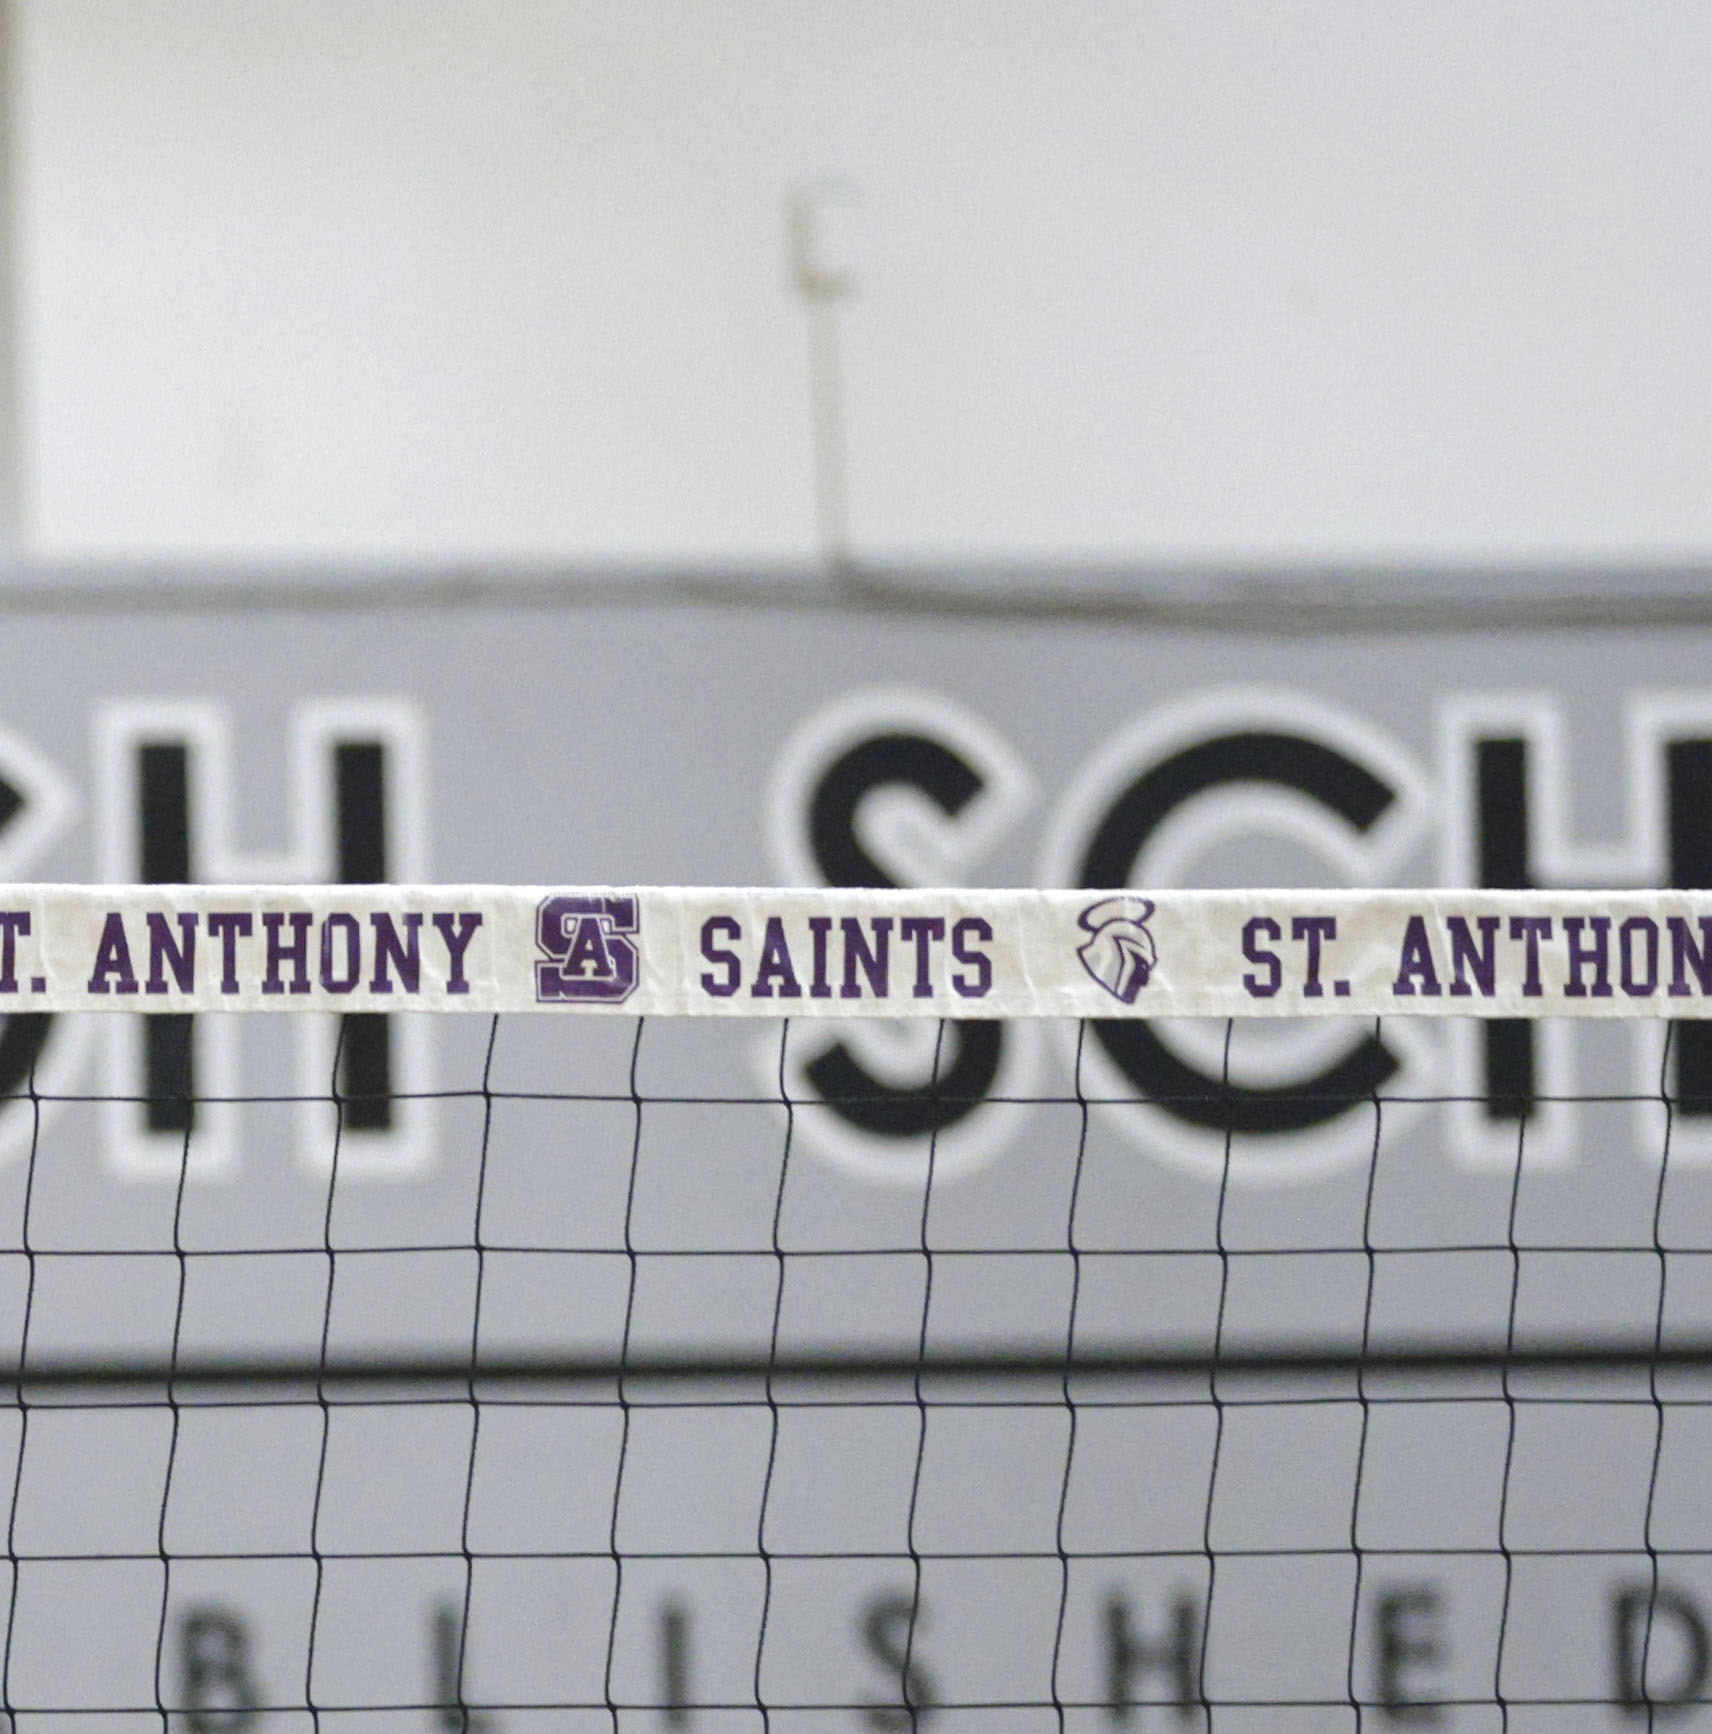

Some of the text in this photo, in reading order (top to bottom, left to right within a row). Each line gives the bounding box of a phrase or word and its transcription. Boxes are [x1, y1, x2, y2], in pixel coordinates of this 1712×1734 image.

[87, 912, 483, 995] ANTHONY
[700, 915, 993, 999] SAINTS
[1241, 916, 1351, 998] ST.
